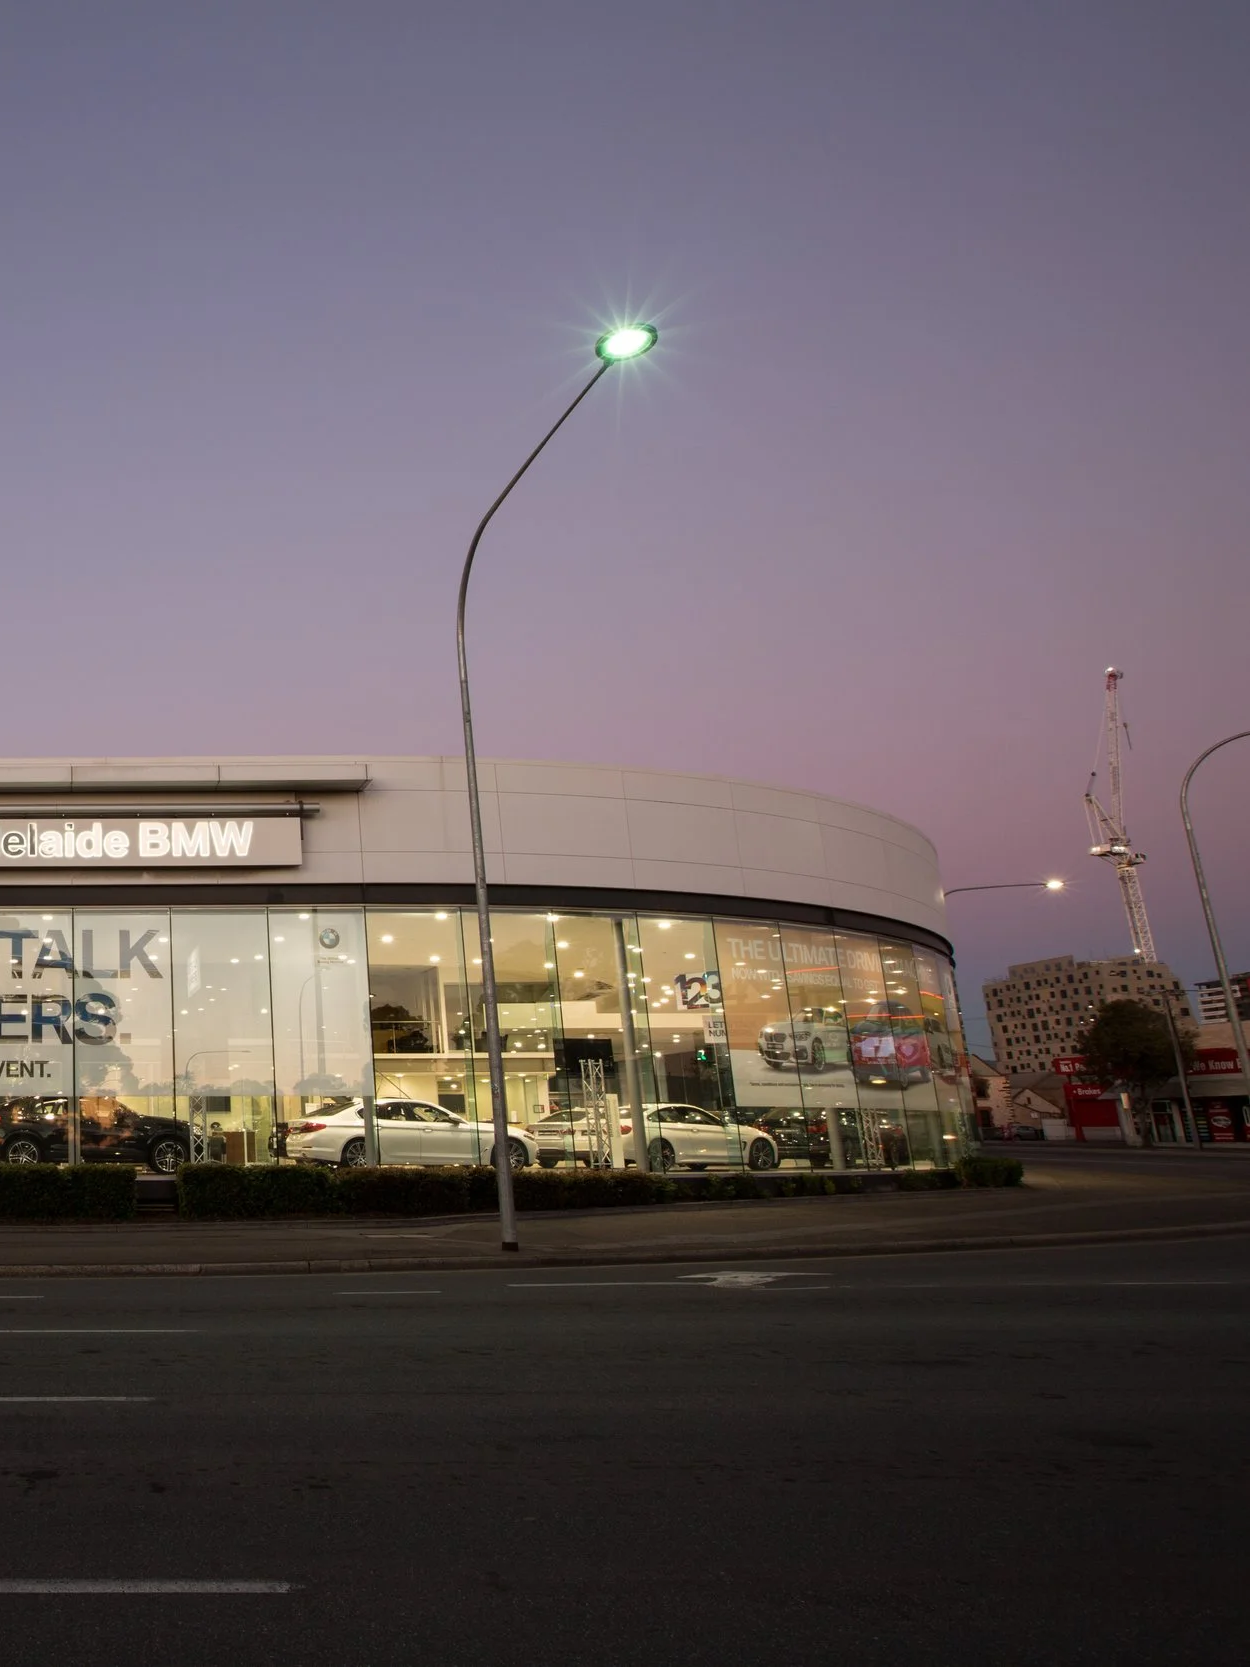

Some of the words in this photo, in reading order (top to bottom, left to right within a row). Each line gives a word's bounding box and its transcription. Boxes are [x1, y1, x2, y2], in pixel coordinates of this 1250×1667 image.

[138, 821, 254, 858] BMW
[726, 938, 767, 960] THE
[768, 941, 847, 967] ULTIMATE
[1208, 1059, 1234, 1071] Know
[1077, 1087, 1102, 1096] Brakes
